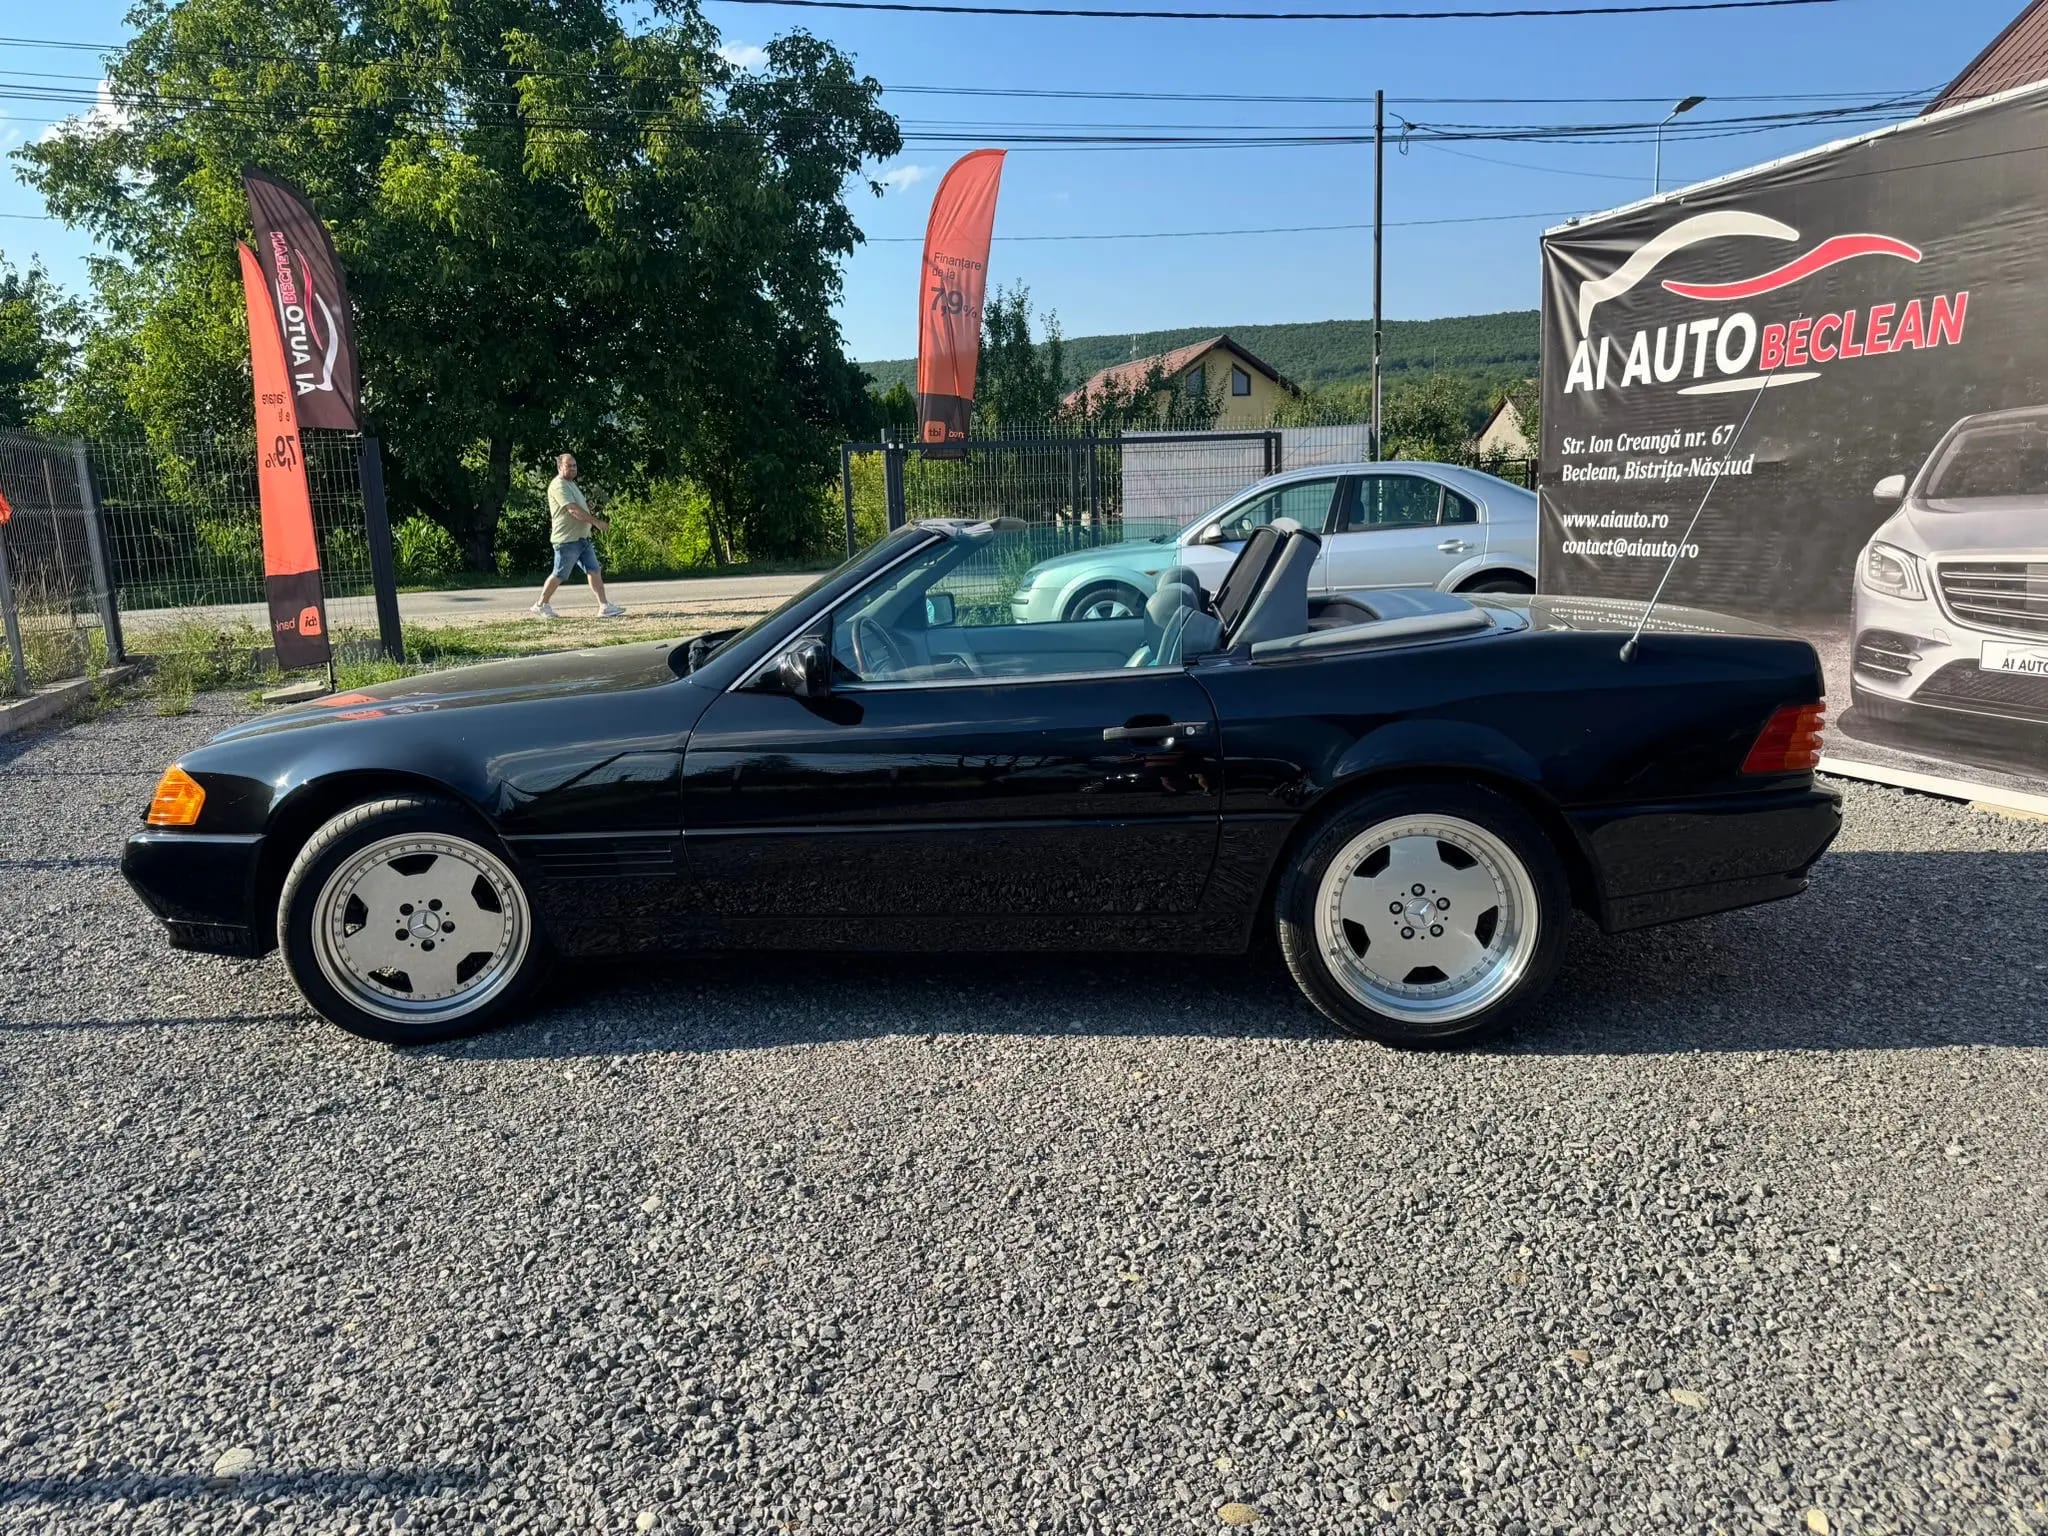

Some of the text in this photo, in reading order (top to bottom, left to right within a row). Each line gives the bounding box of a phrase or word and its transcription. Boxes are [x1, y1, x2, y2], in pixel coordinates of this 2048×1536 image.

[932, 266, 956, 280] de la
[1563, 291, 1969, 394] AI AUTO BECLEAN
[928, 427, 942, 437] tbi
[1562, 424, 1735, 455] Str. Ion Creangă nr. 67
[1562, 463, 1621, 482] Beclean,
[1562, 510, 1669, 528] www.aiauto.ro
[1562, 538, 1699, 559] contact@aiautoro
[2001, 658, 2015, 670] AI
